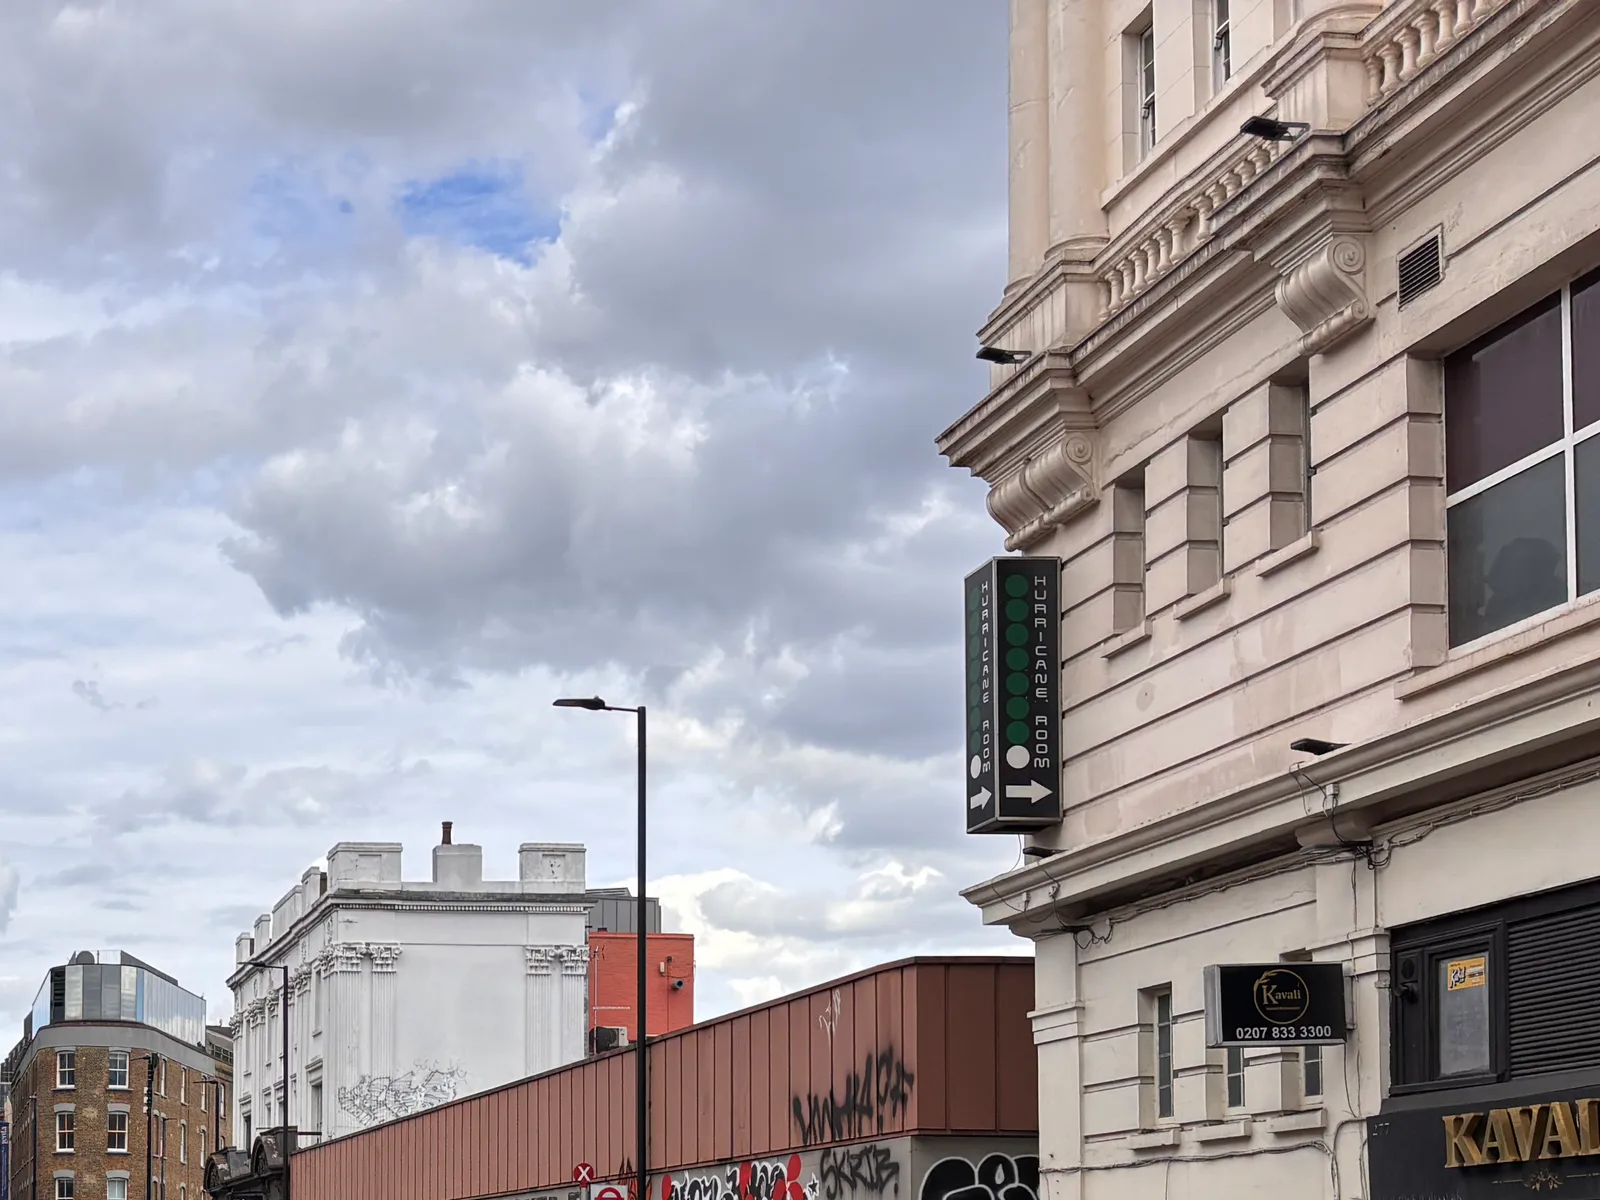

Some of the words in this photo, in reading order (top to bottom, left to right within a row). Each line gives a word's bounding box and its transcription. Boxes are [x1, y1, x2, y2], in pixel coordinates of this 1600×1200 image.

[981, 581, 989, 704] HURRICANE
[1034, 576, 1048, 698] HURRICANE
[983, 720, 991, 773] ROOM
[1034, 715, 1050, 769] ROOM
[1262, 984, 1301, 1005] Kavali
[1236, 1027, 1267, 1039] 0207
[1272, 1027, 1296, 1038] 833
[1300, 1025, 1332, 1038] 3300
